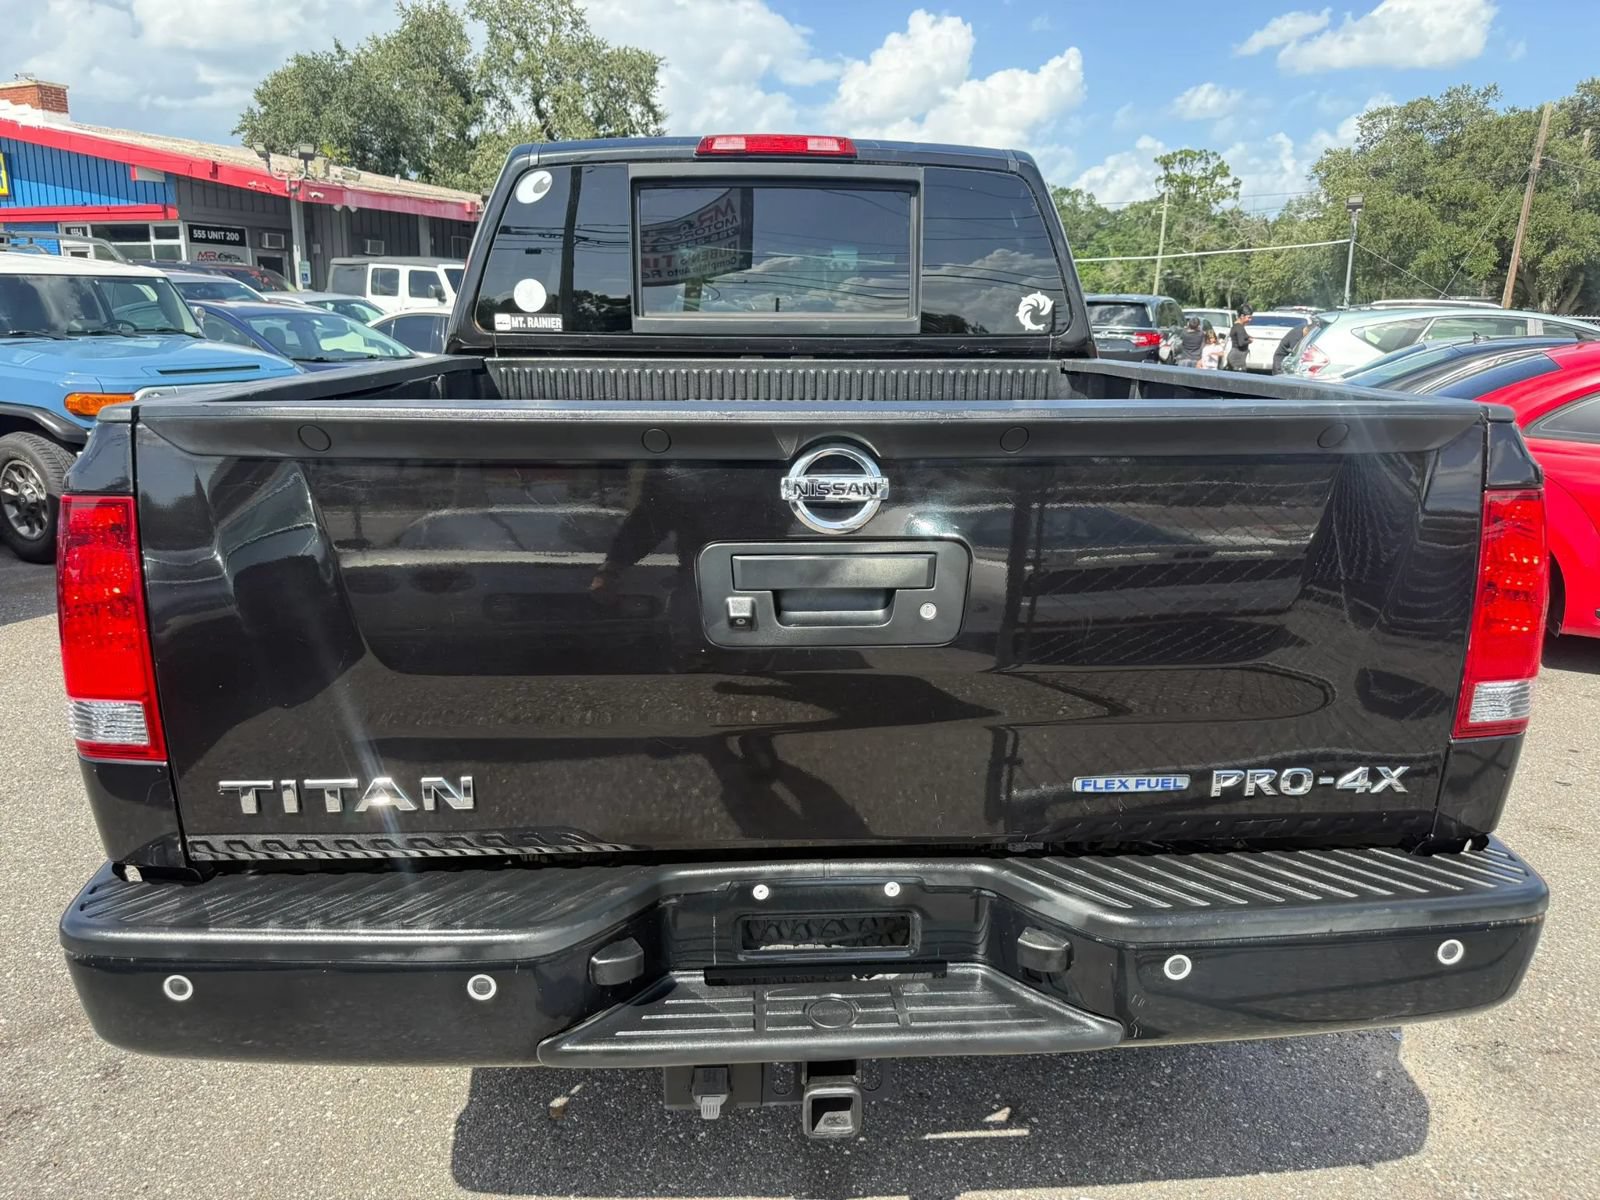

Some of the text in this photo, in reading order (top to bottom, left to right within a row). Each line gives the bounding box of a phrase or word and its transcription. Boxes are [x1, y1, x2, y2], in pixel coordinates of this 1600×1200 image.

[193, 229, 240, 241] 555 UNIT 200
[511, 316, 562, 329] MT. RAINIER
[794, 482, 877, 497] NISSAN
[1081, 777, 1184, 791] FLEX FUEL
[1210, 766, 1411, 798] PRO-4X
[218, 776, 475, 814] TITAN
